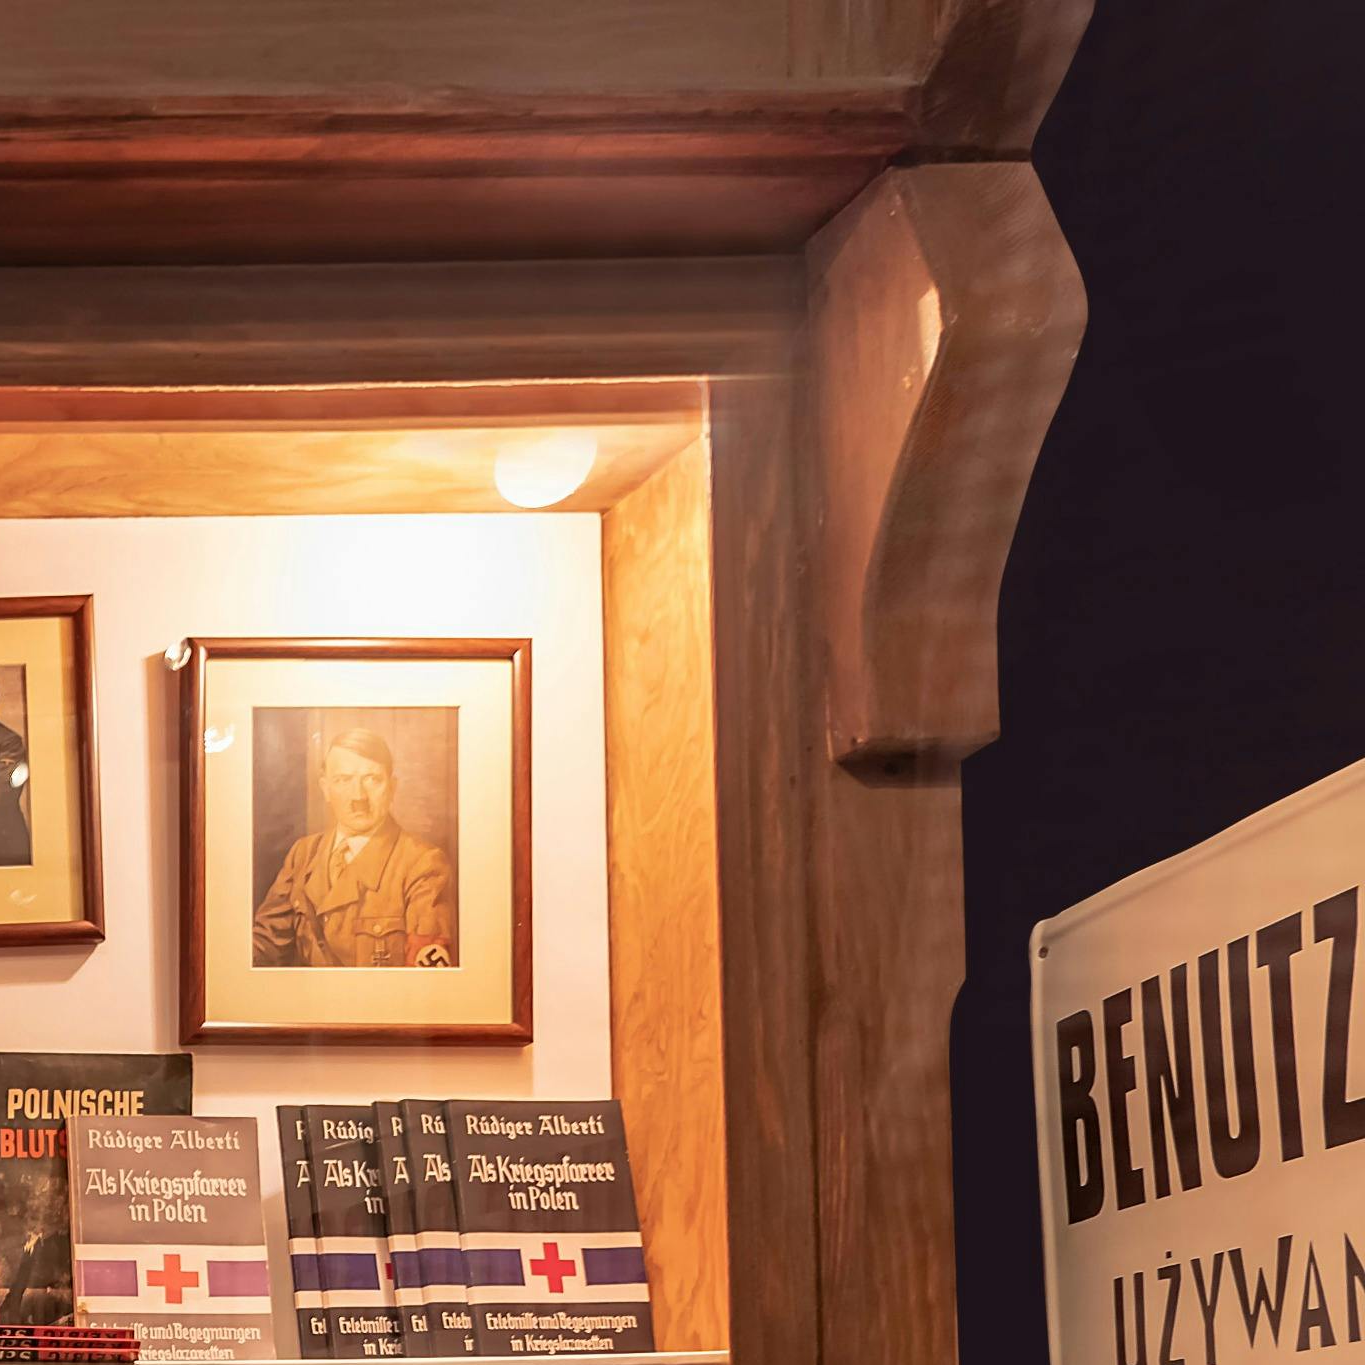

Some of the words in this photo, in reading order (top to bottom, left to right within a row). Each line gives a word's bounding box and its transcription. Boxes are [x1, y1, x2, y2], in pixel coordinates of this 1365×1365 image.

[1056, 885, 1365, 1225] BENUTZ
[7, 1088, 144, 1120] POLNISCHE
[88, 1128, 163, 1153] Rüdiger
[170, 1130, 241, 1150] Alberti
[465, 1115, 533, 1140] Rüdiger
[538, 1115, 605, 1136] Alberti
[85, 1168, 118, 1196] Als
[119, 1168, 247, 1201] Kriegspfarrer
[468, 1154, 497, 1183] Als
[498, 1155, 616, 1187] Kriegspfarrer
[129, 1197, 151, 1221] in
[152, 1198, 208, 1223] Polen
[508, 1186, 529, 1210] in
[530, 1186, 580, 1211] Polen
